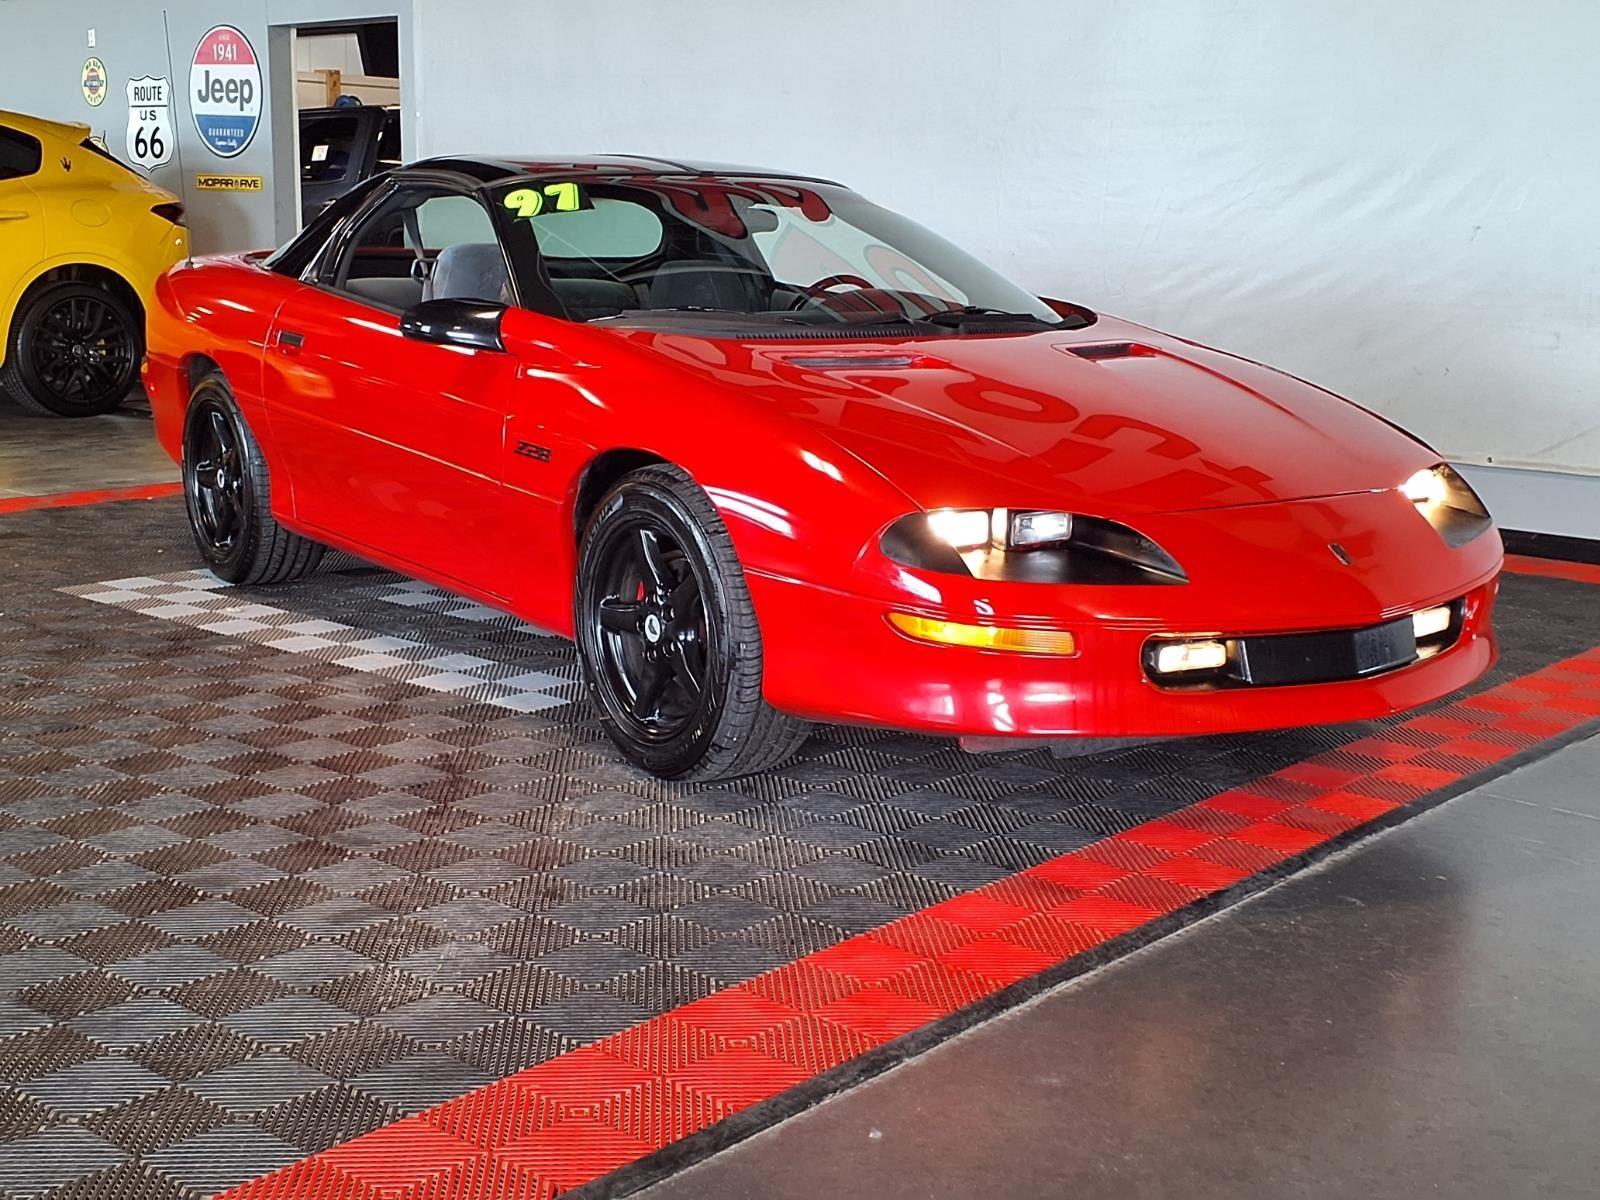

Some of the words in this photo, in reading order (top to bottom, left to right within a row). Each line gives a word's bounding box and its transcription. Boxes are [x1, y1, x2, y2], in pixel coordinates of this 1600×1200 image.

[213, 43, 237, 61] 1941
[134, 86, 162, 101] ROUTE
[197, 69, 254, 112] Jeep
[140, 109, 157, 121] US
[208, 127, 244, 138] GUARANTEED
[134, 126, 165, 159] 66
[198, 178, 234, 188] MOPAR
[240, 179, 259, 188] AVE
[503, 182, 580, 218] 97
